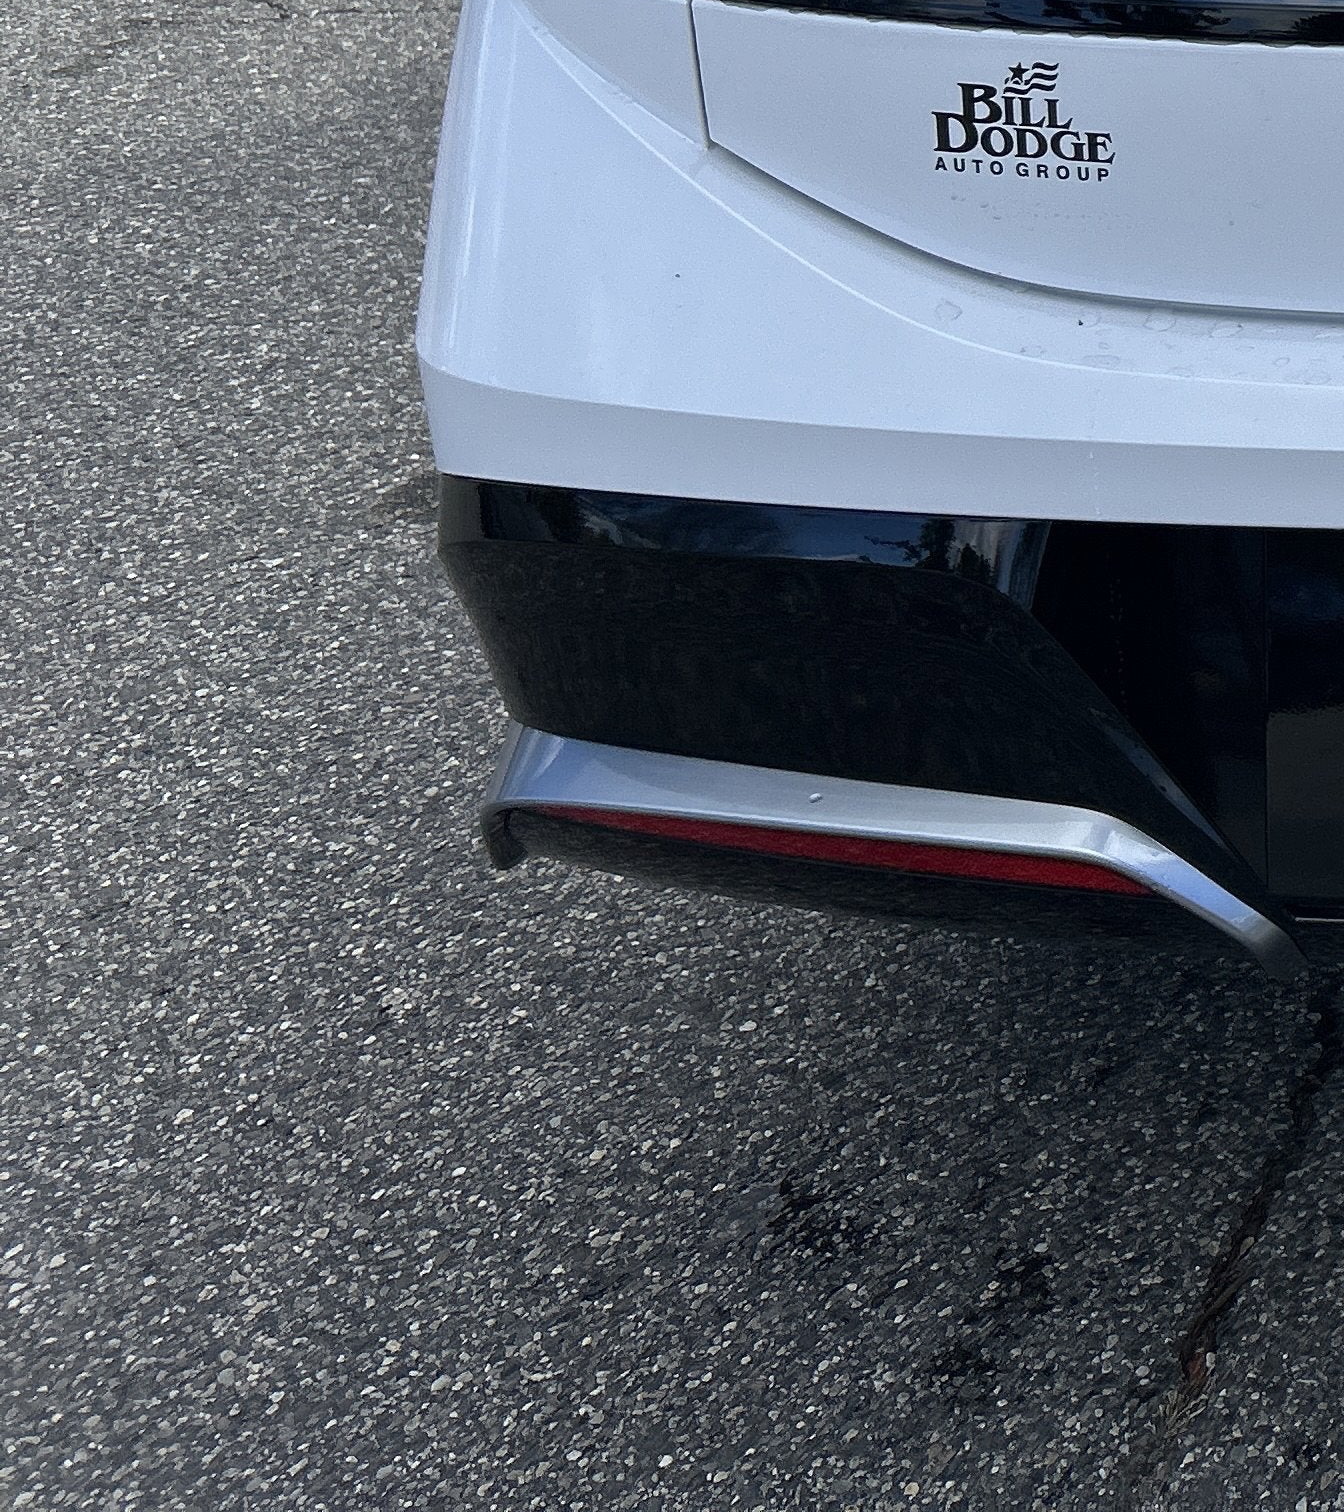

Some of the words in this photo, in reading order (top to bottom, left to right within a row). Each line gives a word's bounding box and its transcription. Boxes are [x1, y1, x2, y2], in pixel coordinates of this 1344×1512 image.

[957, 82, 1073, 129] BILL
[931, 111, 1116, 164] DODGE
[935, 156, 1004, 176] AUTO
[1015, 162, 1110, 182] GROUP
